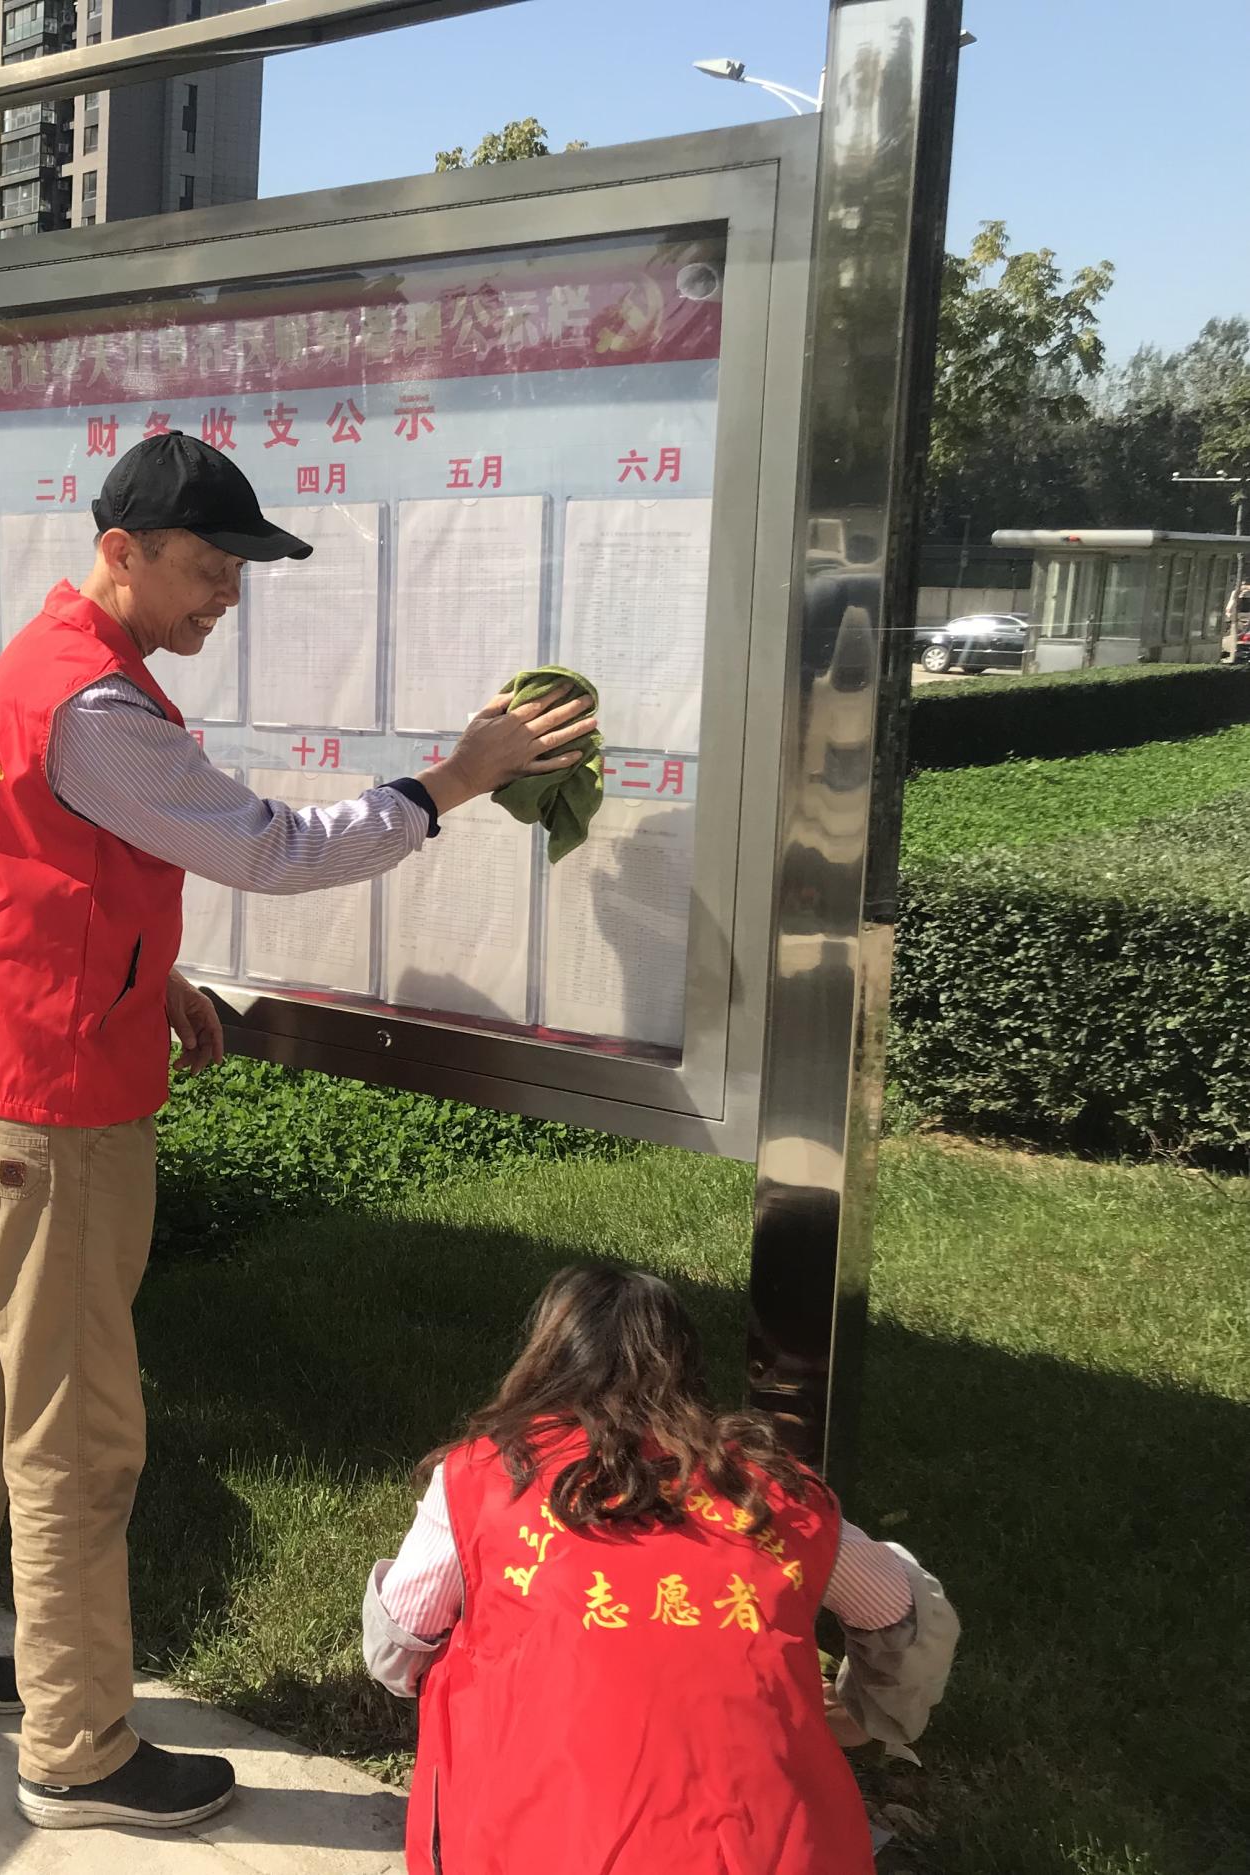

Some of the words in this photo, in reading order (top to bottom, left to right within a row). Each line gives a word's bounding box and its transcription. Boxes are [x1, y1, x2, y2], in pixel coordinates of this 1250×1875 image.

[86, 394, 436, 459] 财务收支公示
[35, 475, 77, 503] 二月
[296, 462, 347, 495] 四月
[446, 455, 503, 489] 五月
[617, 446, 681, 483] 六月
[292, 736, 341, 769] 十月
[582, 1571, 762, 1634] 志愿者
